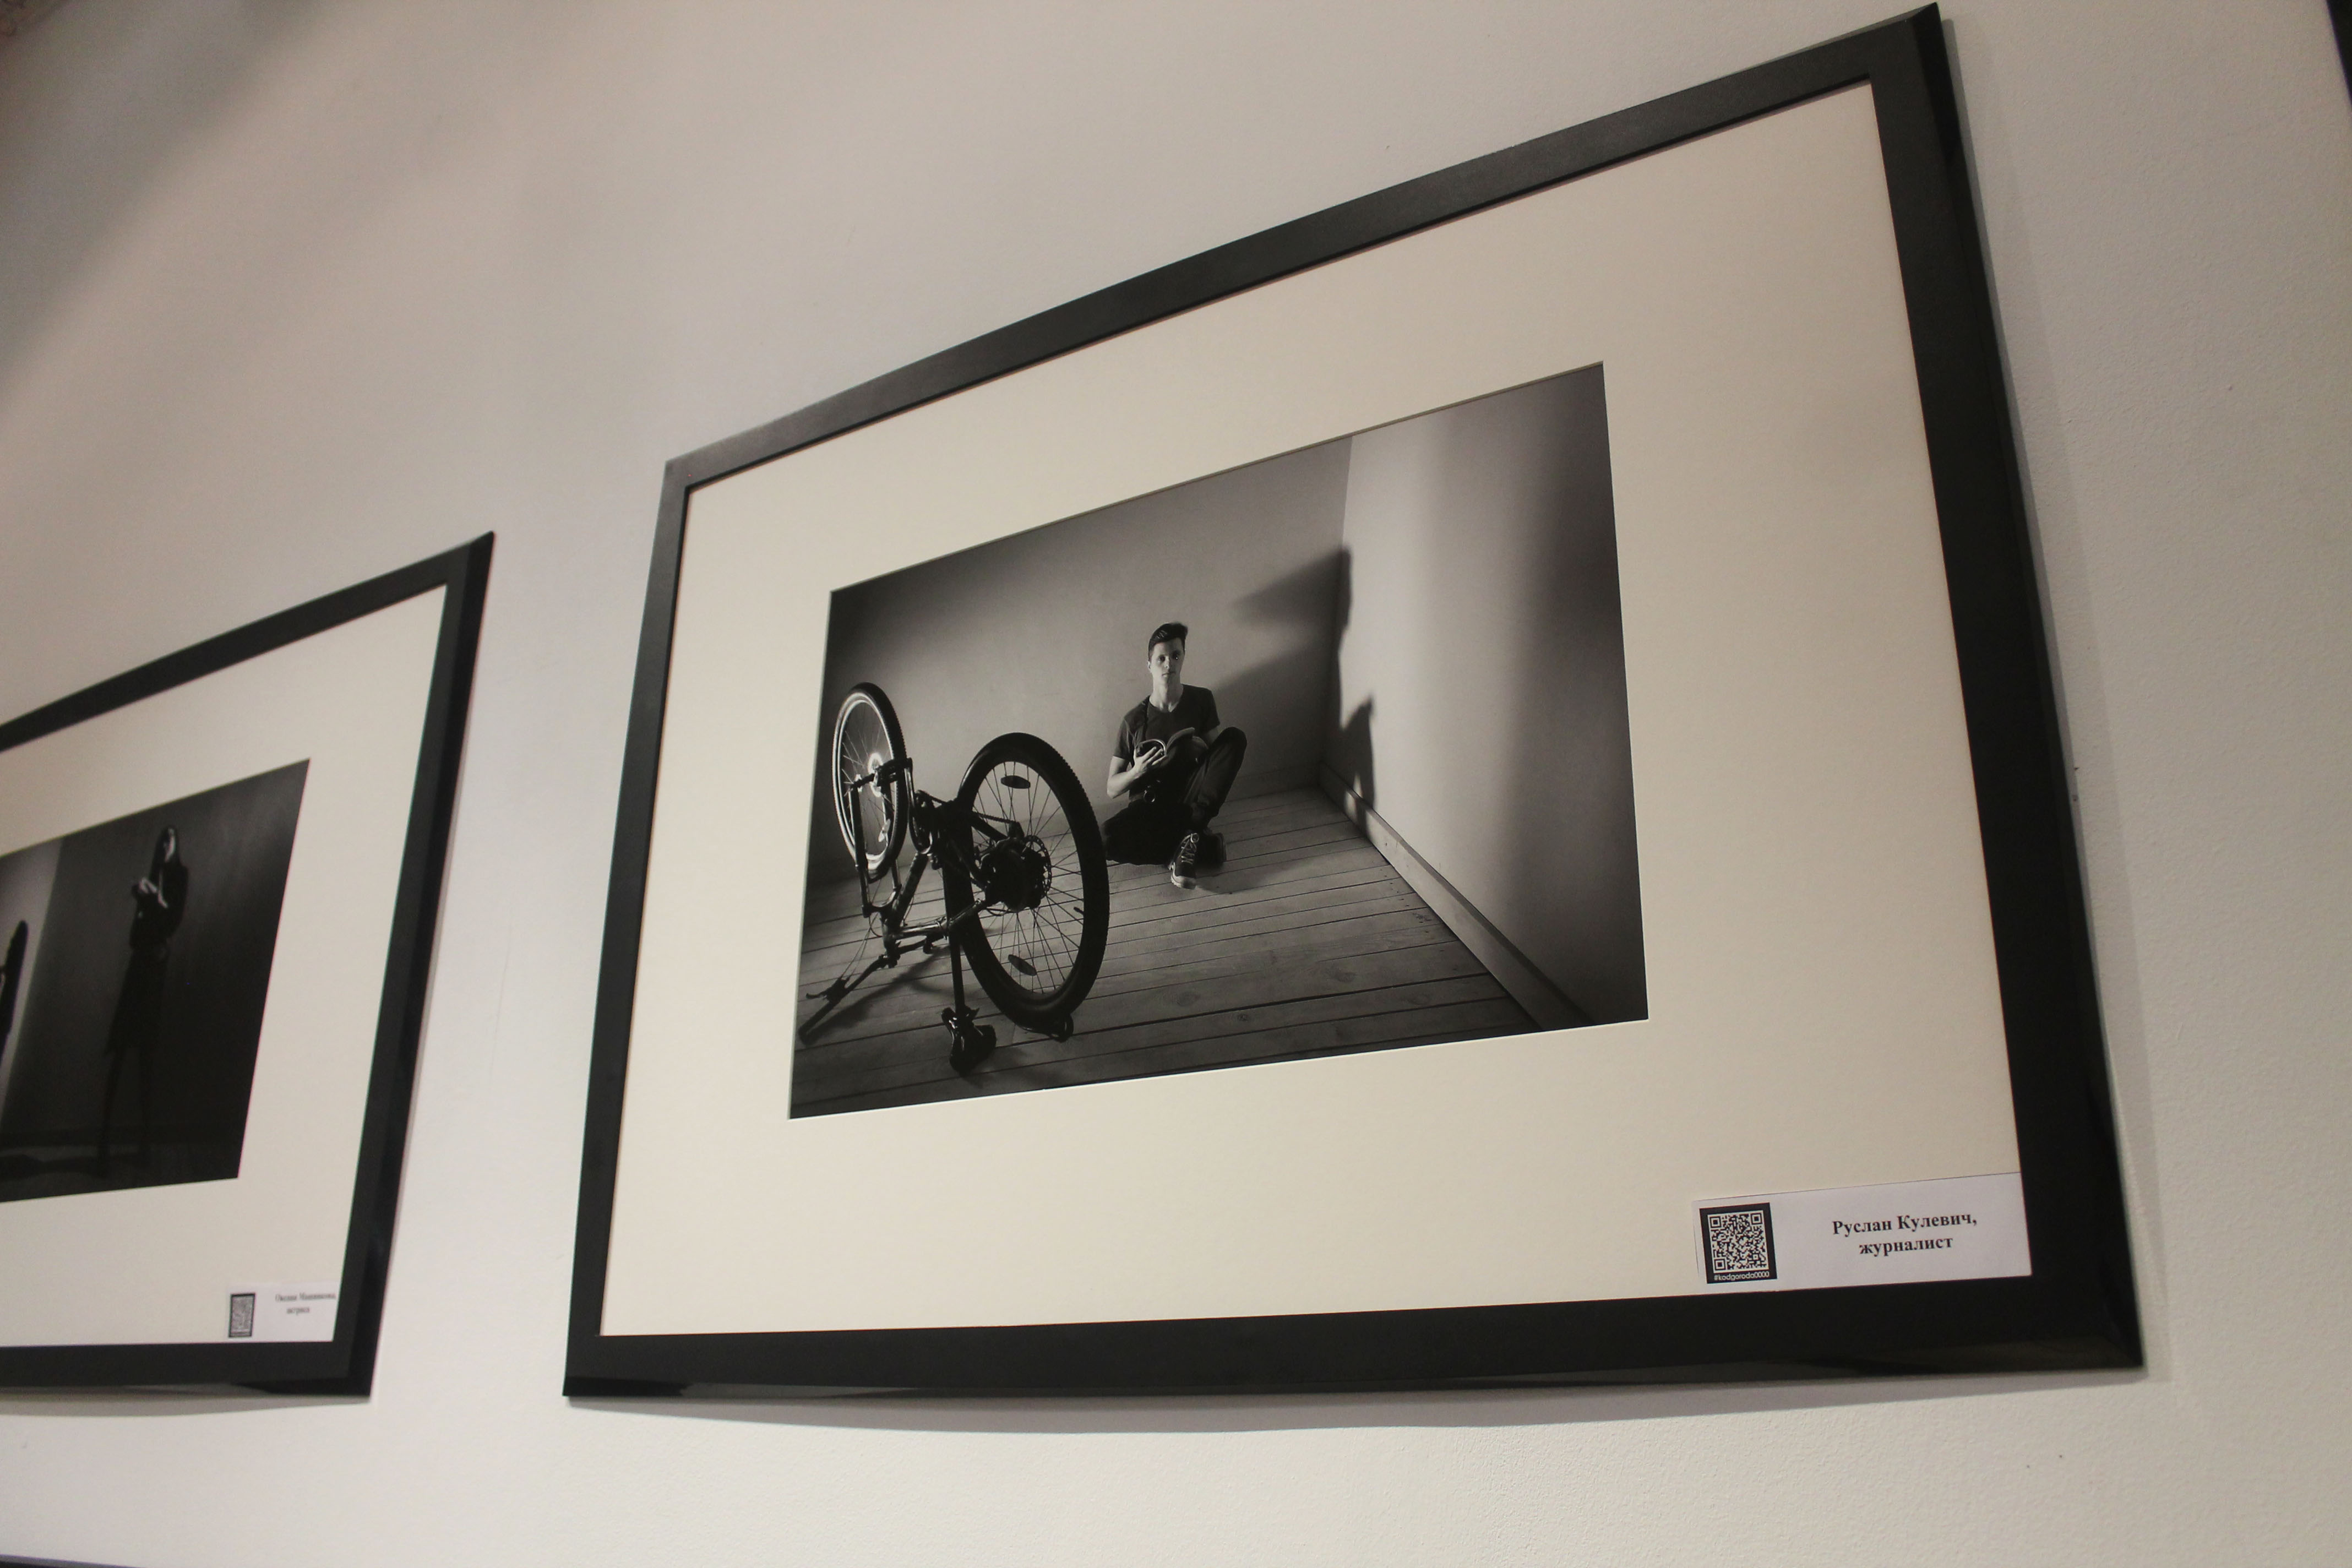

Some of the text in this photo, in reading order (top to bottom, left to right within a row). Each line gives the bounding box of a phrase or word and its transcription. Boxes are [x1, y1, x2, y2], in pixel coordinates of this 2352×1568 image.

[1832, 1214, 1977, 1237] Руслан Кулевич,
[1859, 1238, 1953, 1257] журналист
